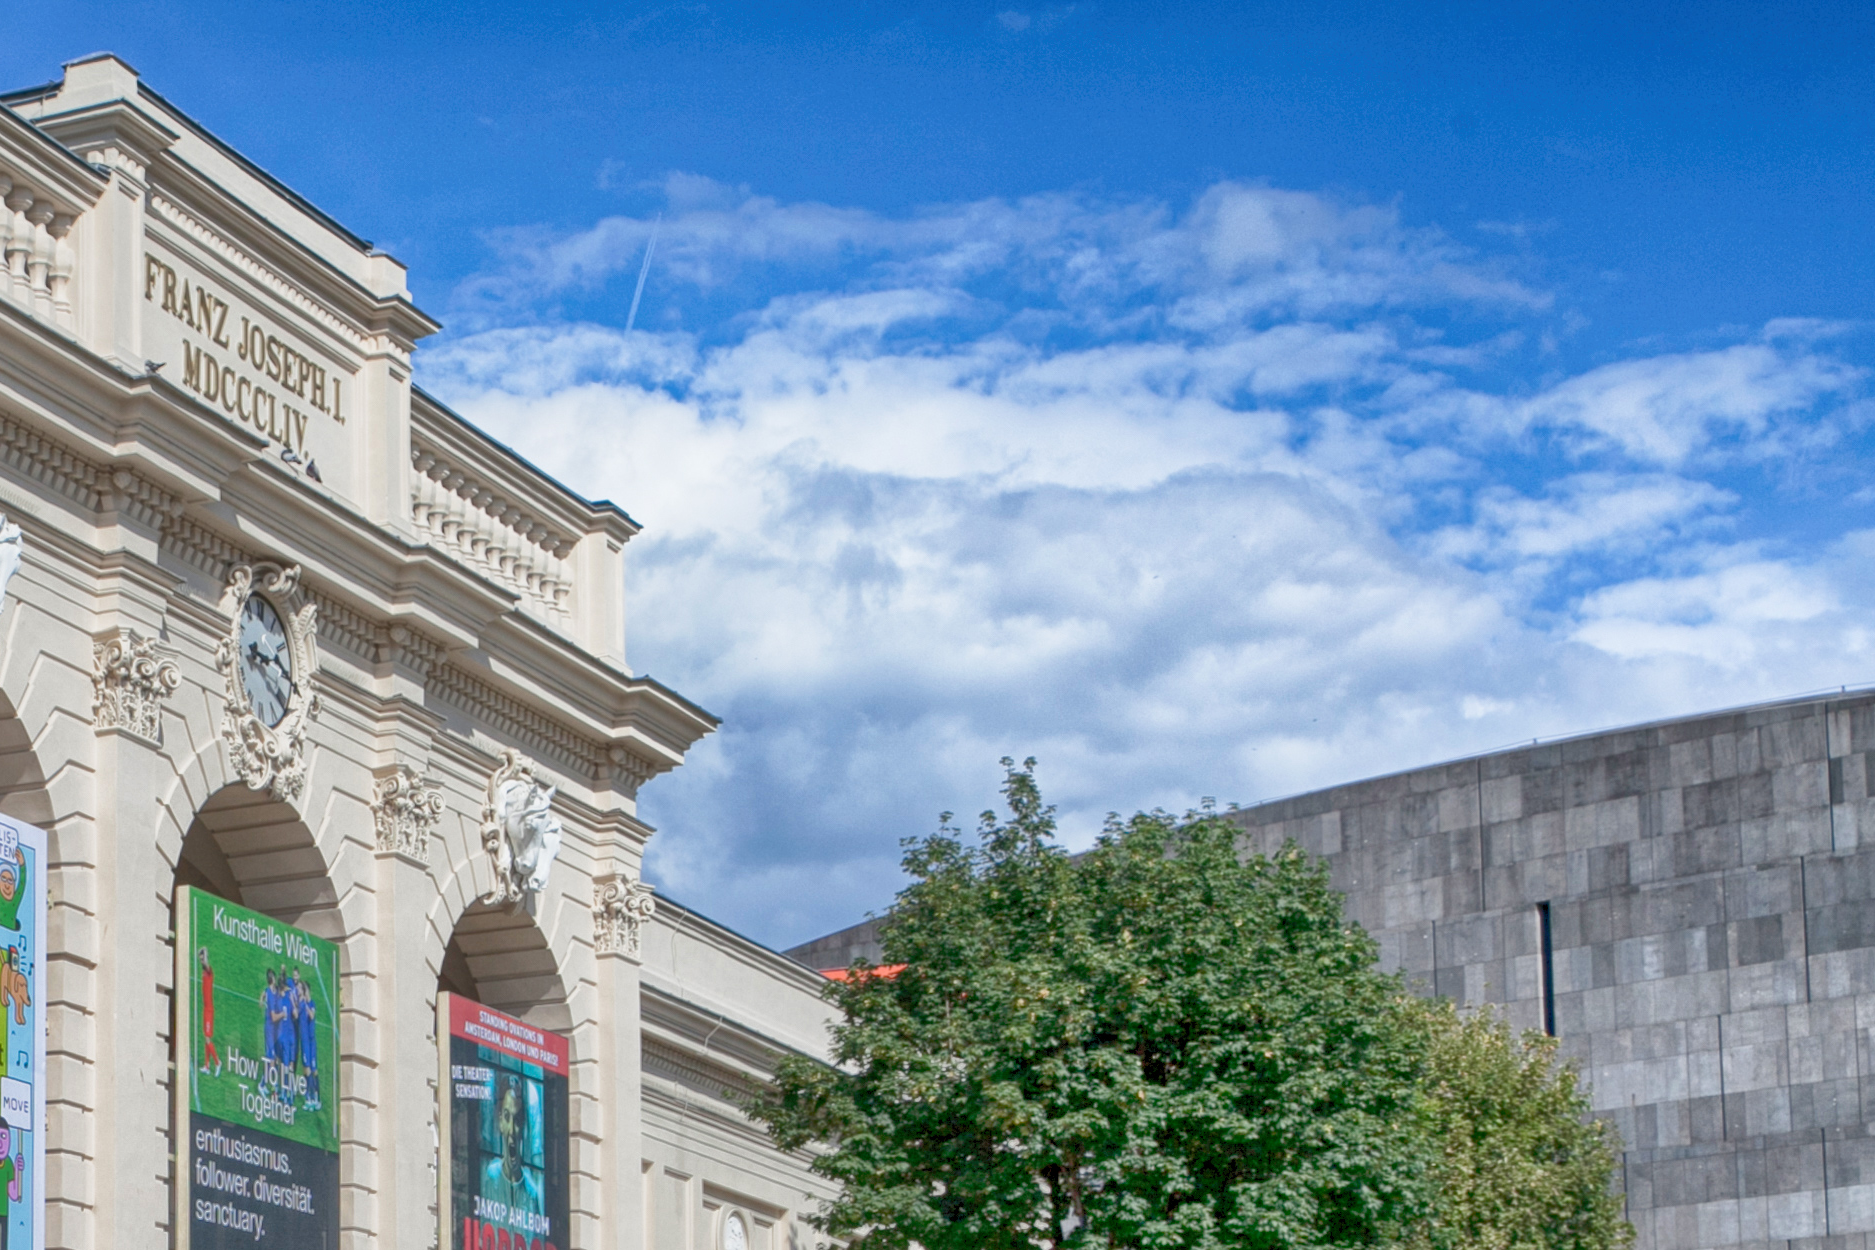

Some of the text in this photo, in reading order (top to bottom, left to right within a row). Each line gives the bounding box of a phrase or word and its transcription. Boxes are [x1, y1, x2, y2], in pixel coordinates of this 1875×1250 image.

[145, 252, 230, 350] FRANZ
[213, 904, 318, 967] Kunsthalle Wien
[465, 1021, 559, 1067] AMSTERDAM, LONDON UND PARIS!
[479, 1010, 544, 1046] STANDING OVATIONS IN
[227, 1046, 307, 1096] How To Live
[451, 1064, 494, 1082] DIE THEATER-
[3, 1096, 29, 1113] MOVE
[238, 1083, 297, 1125] Together
[195, 1128, 292, 1175] enthusiasmus.
[195, 1157, 315, 1215] follower. diversität.
[195, 1198, 265, 1241] sanctuary.
[473, 1195, 550, 1236] JAKOP AHLBOM
